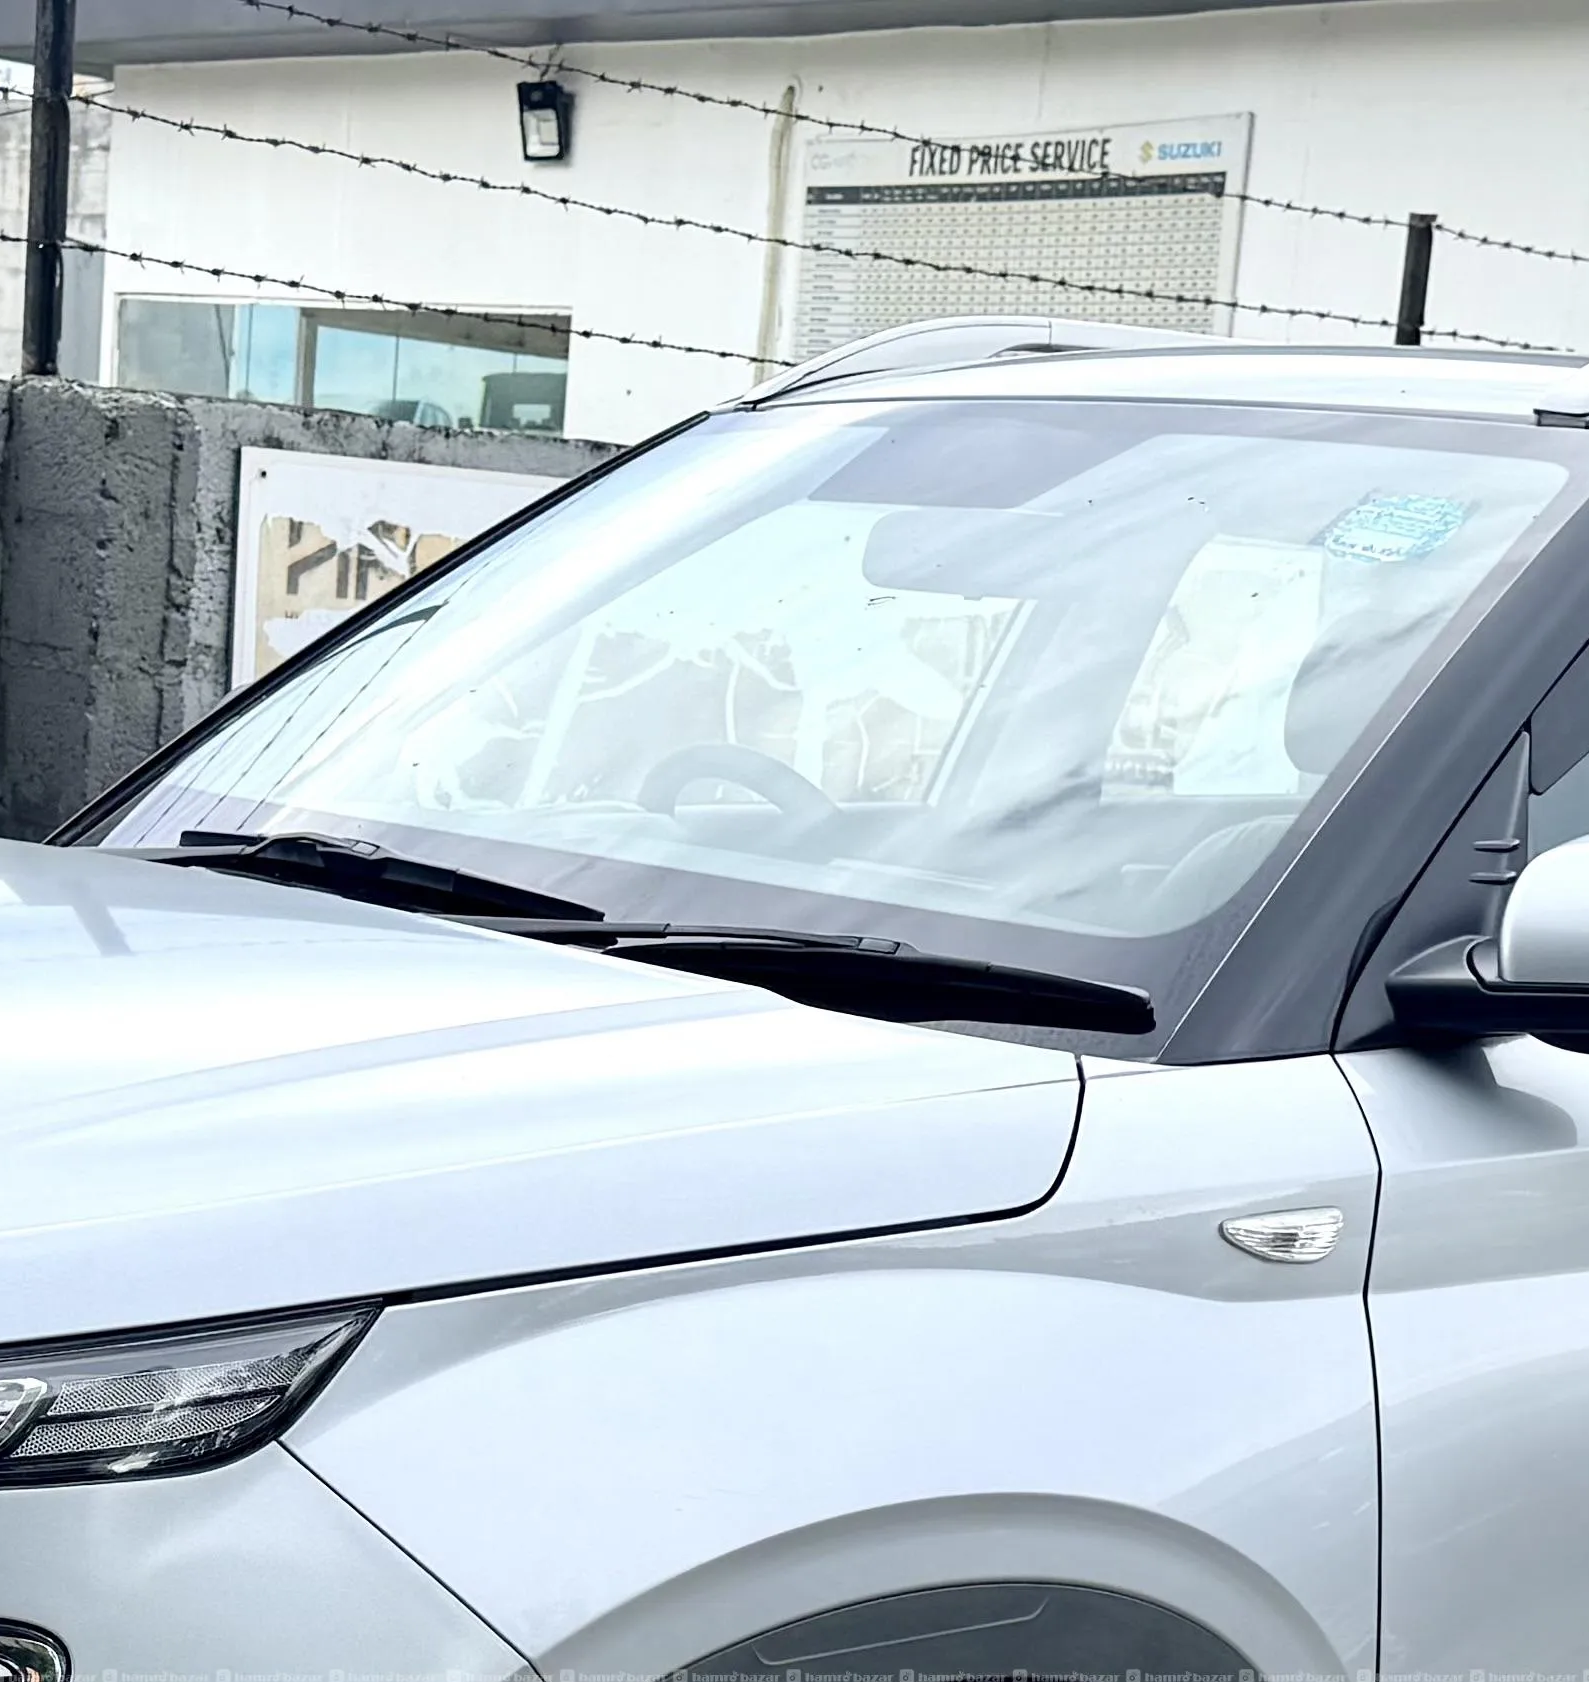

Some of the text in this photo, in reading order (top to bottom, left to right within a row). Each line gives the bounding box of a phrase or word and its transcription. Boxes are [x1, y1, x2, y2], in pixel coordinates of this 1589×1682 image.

[909, 145, 961, 177] FIXED
[968, 143, 1024, 175] PRICE
[1029, 138, 1112, 172] SERVICE
[1157, 141, 1222, 160] SUZUKI
